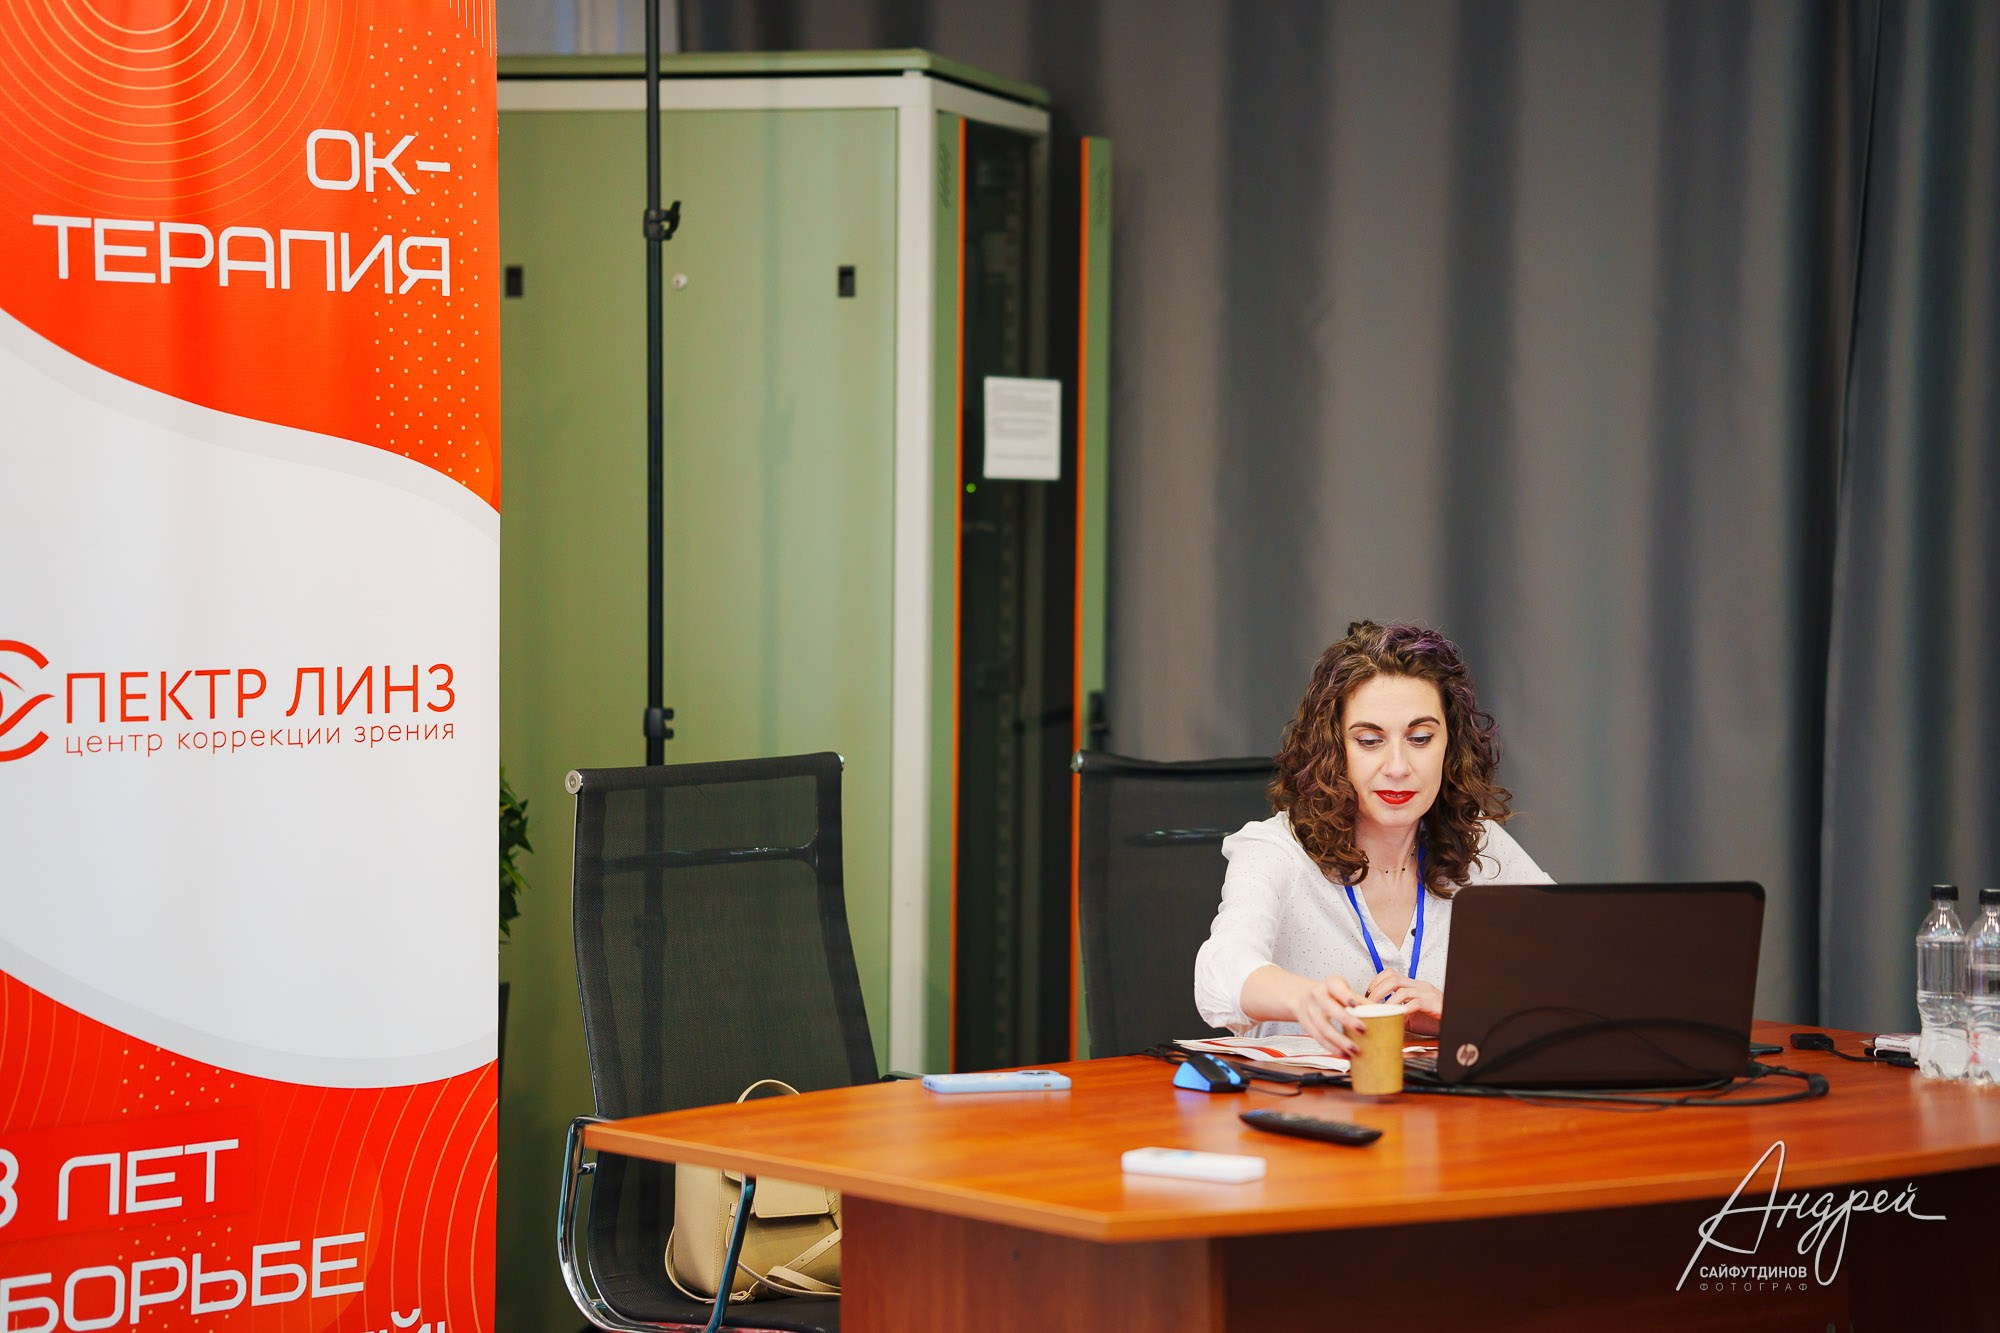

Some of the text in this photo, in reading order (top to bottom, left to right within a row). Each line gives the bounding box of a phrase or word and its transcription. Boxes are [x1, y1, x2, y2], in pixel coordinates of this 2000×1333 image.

[306, 128, 451, 196] ОК-
[32, 214, 451, 297] ТЕРАПИЯ
[285, 663, 455, 716] ЛИНЗ
[65, 723, 455, 758] центр коррекции зрения
[57, 1138, 239, 1222] ЛЕТ
[0, 1231, 365, 1333] БОРЬБЕ
